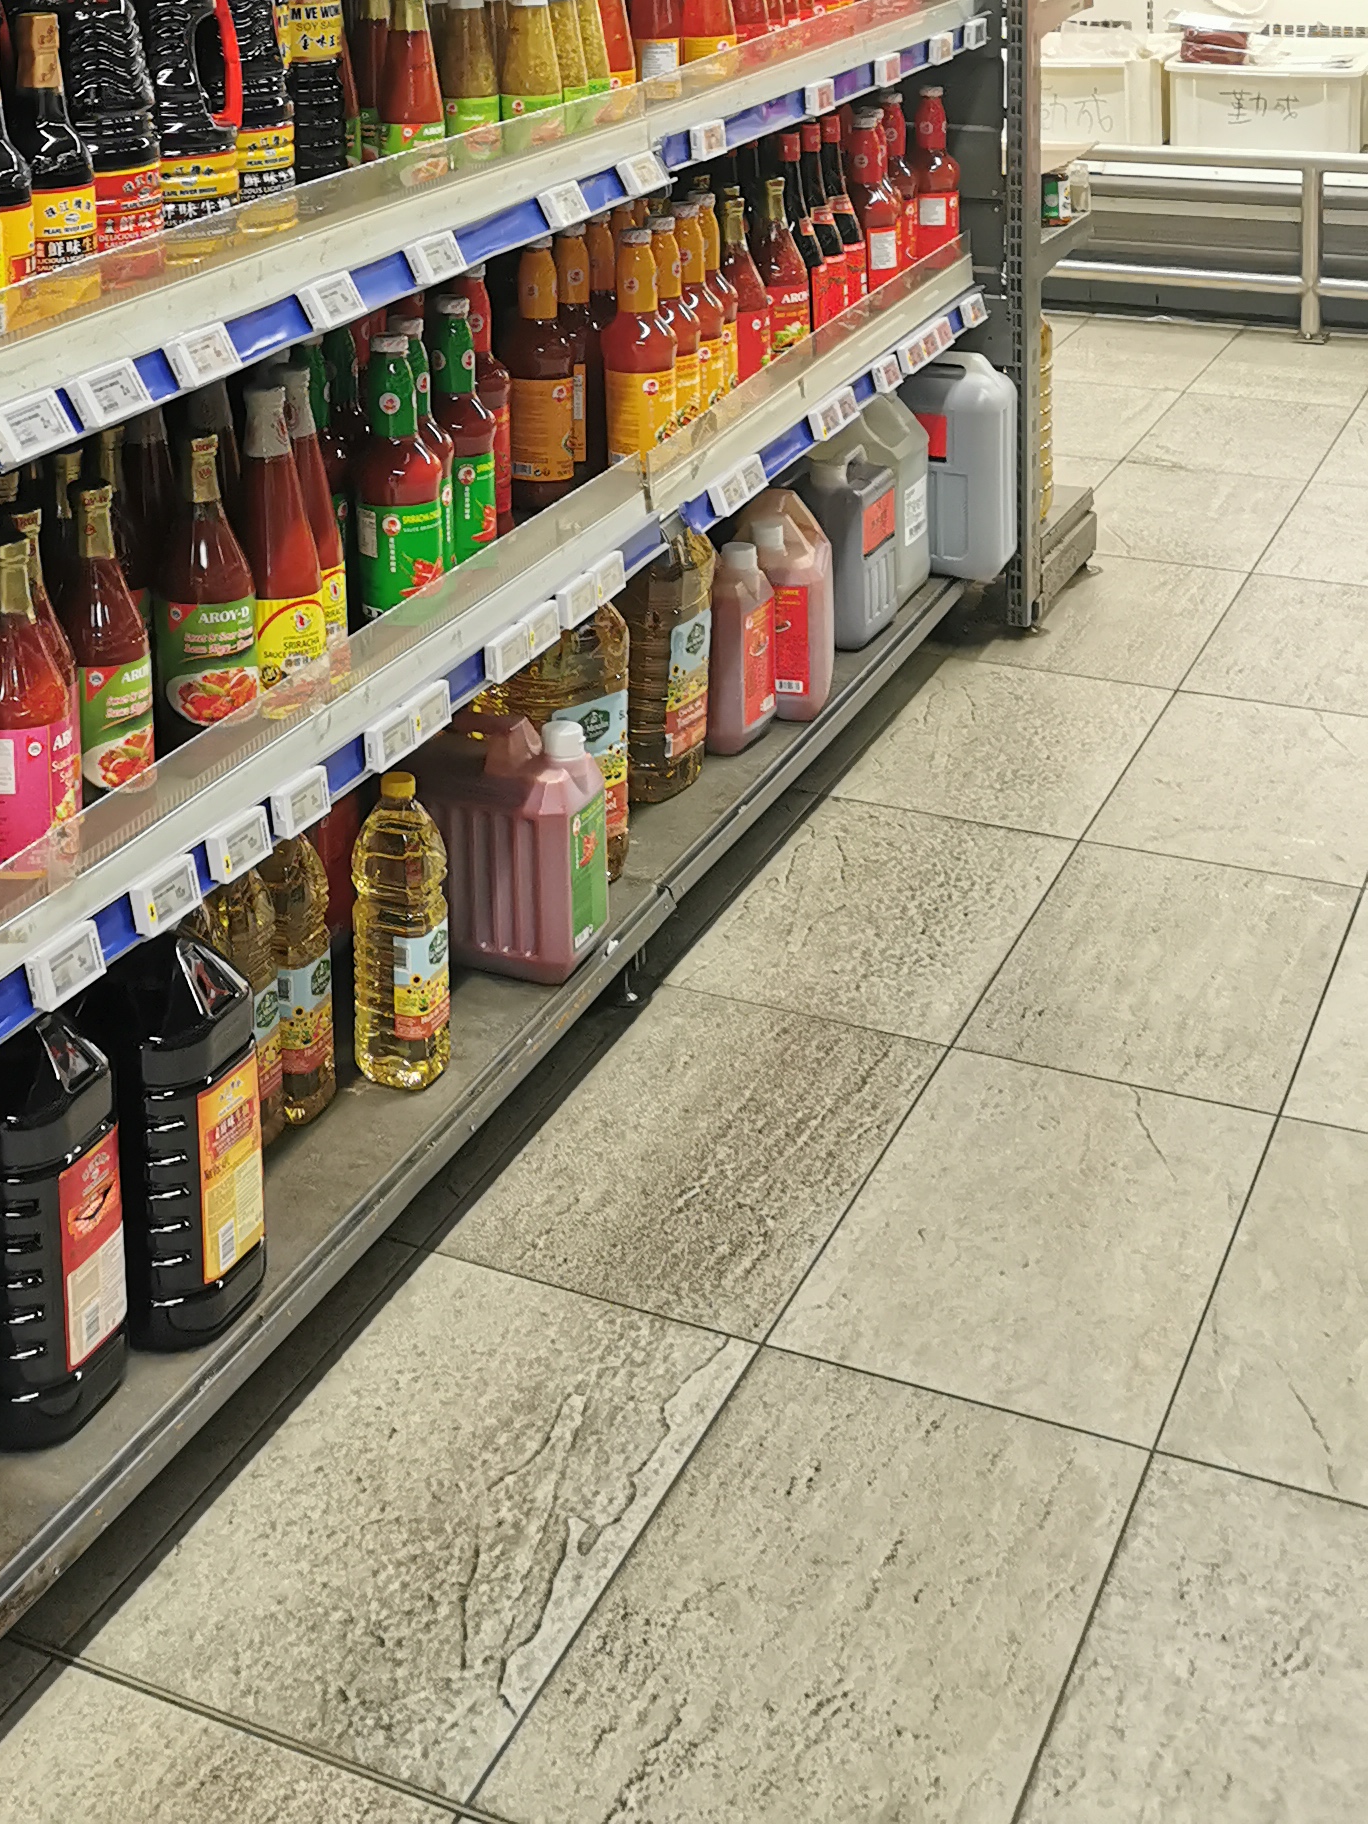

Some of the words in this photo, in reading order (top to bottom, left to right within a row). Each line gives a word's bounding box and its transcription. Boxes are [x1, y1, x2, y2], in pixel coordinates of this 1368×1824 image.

[304, 6, 319, 20] VE
[296, 22, 319, 33] SOY
[179, 187, 199, 196] RIVER
[98, 232, 139, 244] DELICIOUS
[198, 604, 250, 625] AROY-D
[283, 636, 320, 651] SRIRACHA
[263, 650, 286, 659] SAUCE
